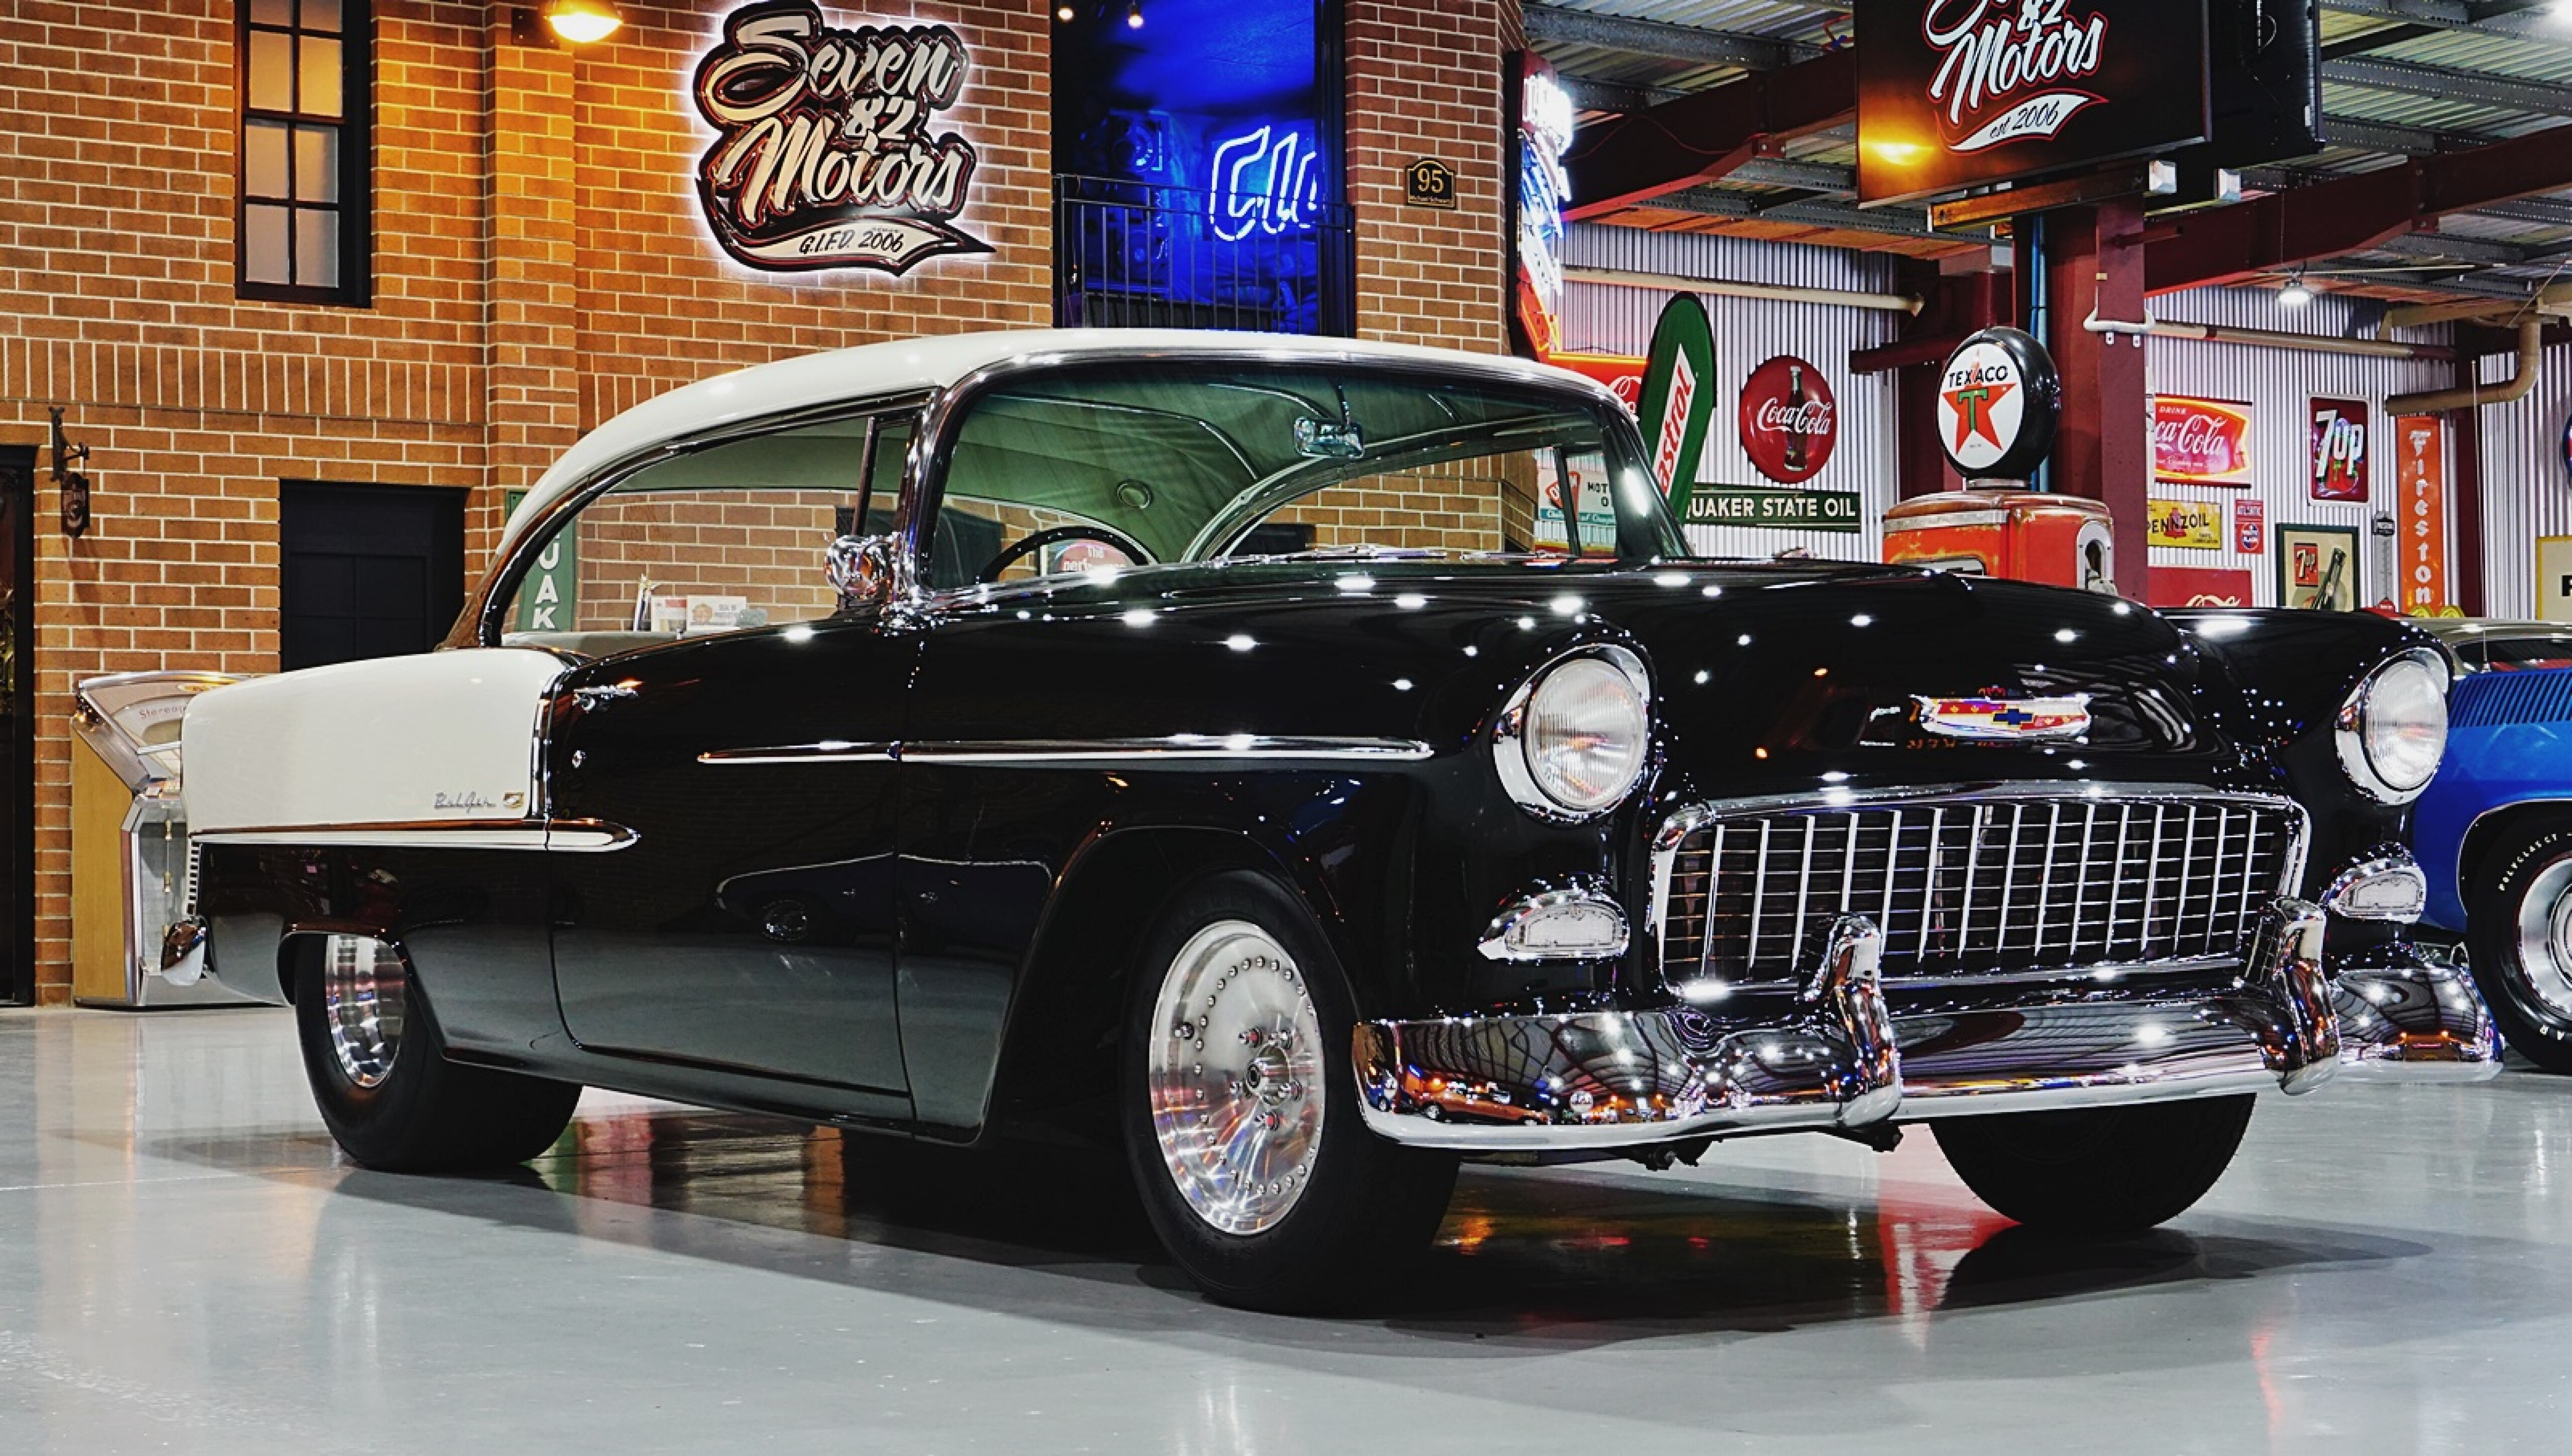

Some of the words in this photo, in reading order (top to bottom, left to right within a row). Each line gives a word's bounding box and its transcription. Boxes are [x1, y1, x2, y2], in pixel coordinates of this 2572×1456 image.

[705, 16, 958, 122] Seven
[1930, 18, 2103, 124] Motors
[845, 96, 917, 141] 82
[2012, 99, 2060, 131] 2006
[718, 115, 962, 224] Motors
[1417, 167, 1444, 193] 95
[858, 230, 904, 253] 2006
[1948, 365, 2008, 388] TEXACO
[1658, 364, 1692, 494] astrol
[1757, 396, 1833, 435] Coca-Cola
[2159, 406, 2187, 415] DRINK
[2155, 414, 2228, 456] ca-Cola
[1587, 482, 1609, 494] MOT
[1686, 497, 1754, 519] UAKER
[1762, 497, 1817, 516] STATE
[1824, 498, 1856, 517] OIL
[2409, 430, 2432, 604] Fireston
